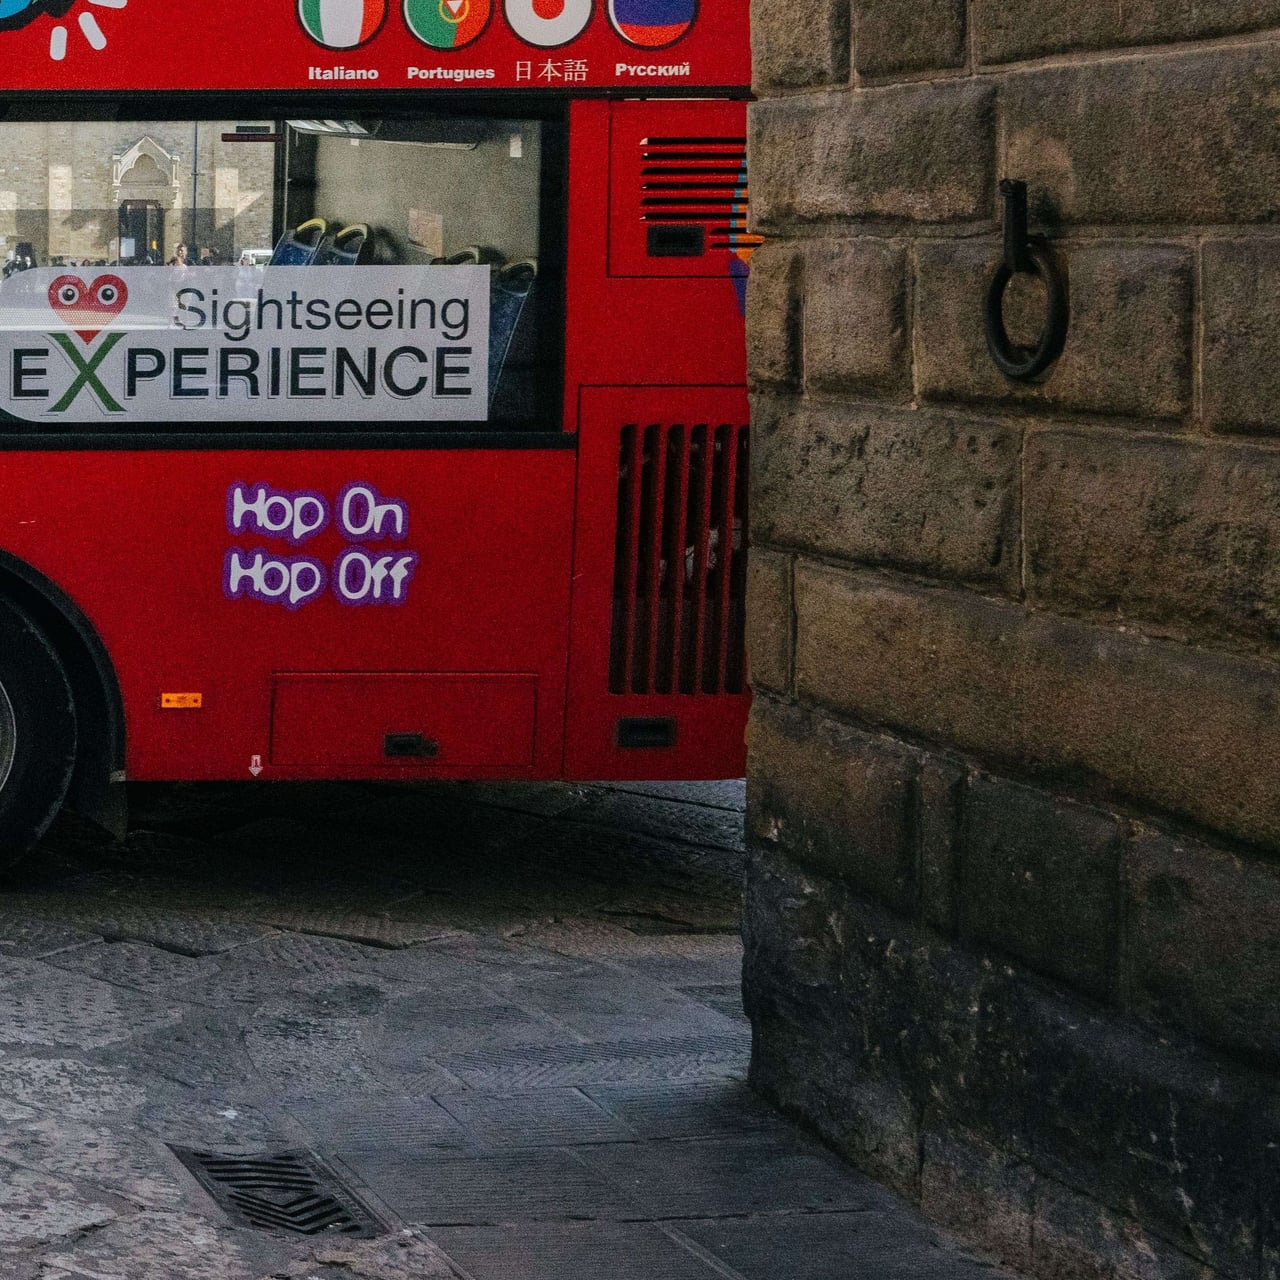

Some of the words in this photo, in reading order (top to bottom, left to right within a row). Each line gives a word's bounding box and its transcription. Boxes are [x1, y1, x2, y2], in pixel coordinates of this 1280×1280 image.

[307, 66, 379, 80] Italiano
[406, 66, 496, 82] Portugues
[515, 58, 589, 82] 日本語
[173, 287, 470, 341] Sightseeing
[10, 332, 472, 413] EXPERIENCE
[229, 485, 327, 541] Hop
[339, 485, 406, 535] On
[226, 552, 324, 607] Hop
[337, 552, 411, 603] Off
